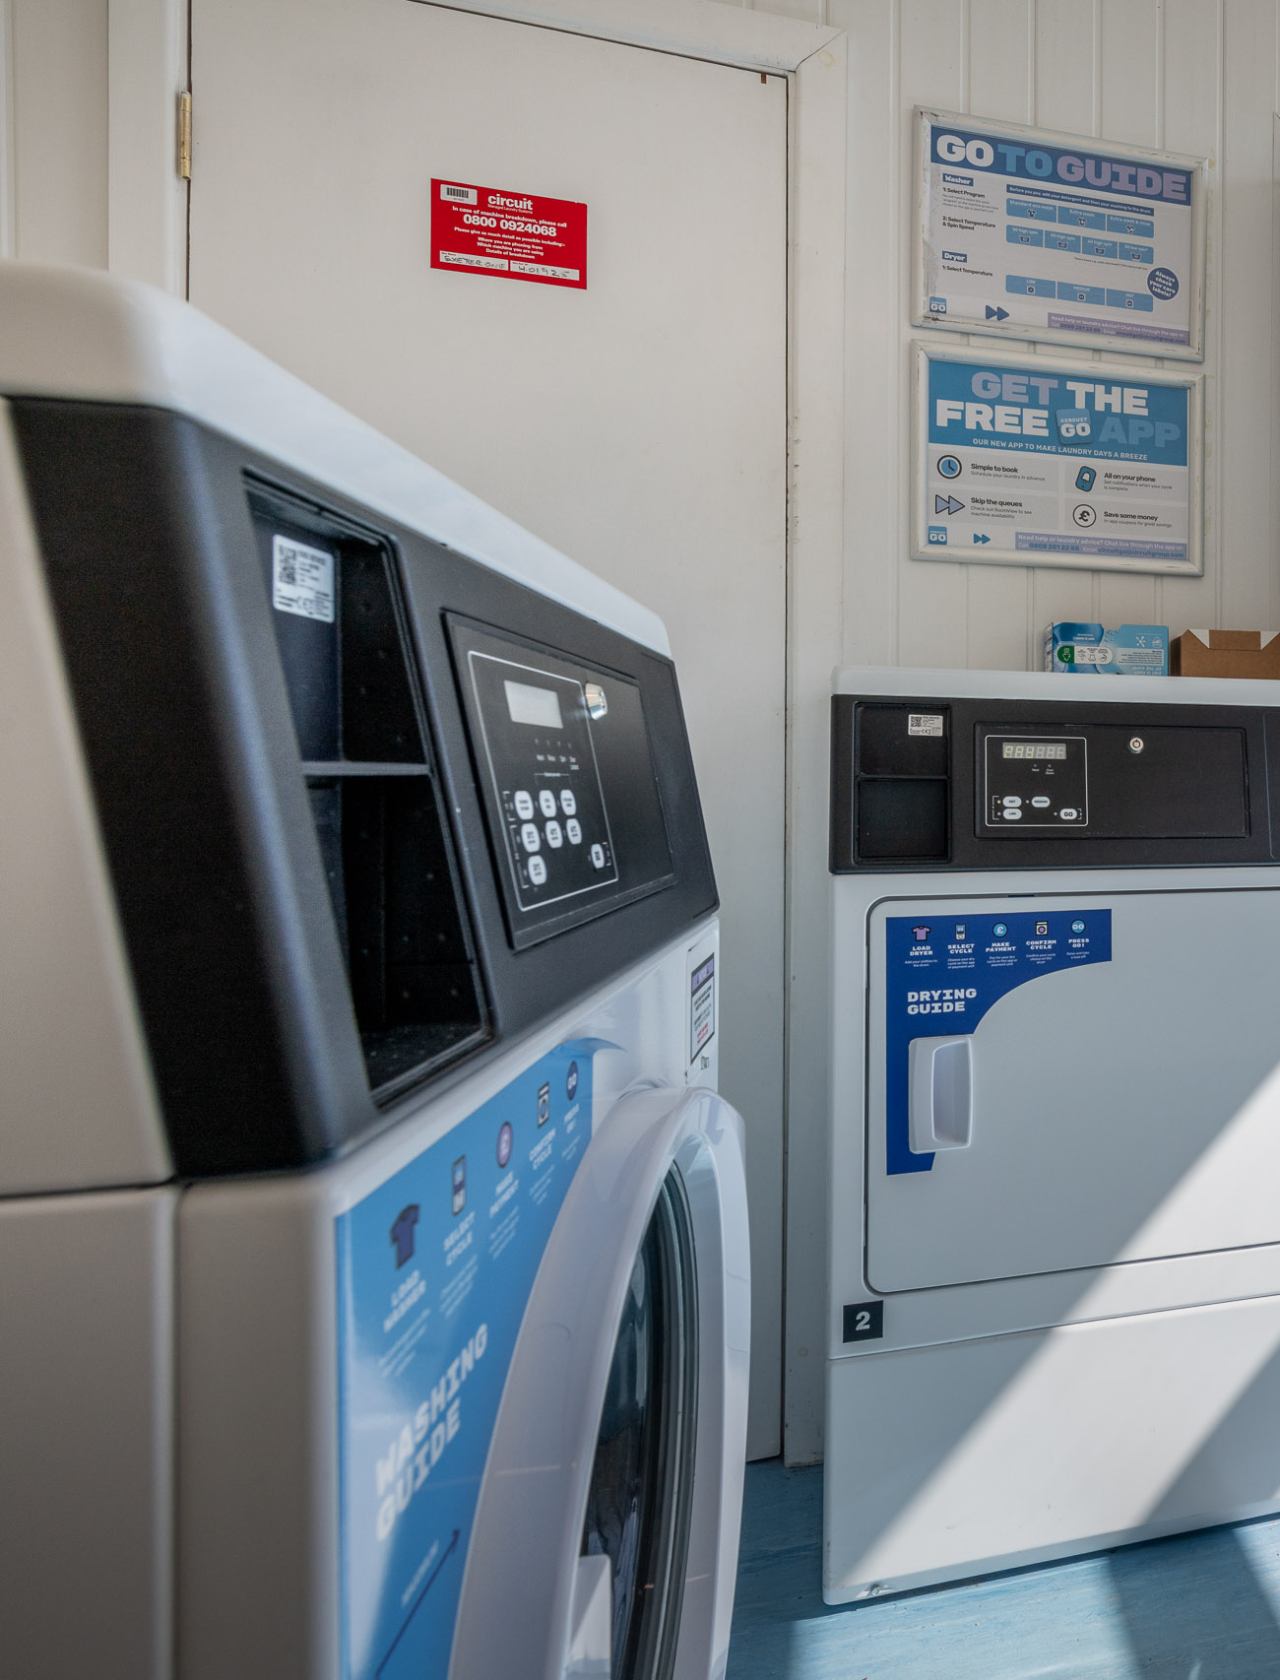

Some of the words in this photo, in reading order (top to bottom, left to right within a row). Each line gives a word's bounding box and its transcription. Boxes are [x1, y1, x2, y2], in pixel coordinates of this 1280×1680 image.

[936, 134, 994, 167] GO
[997, 143, 1053, 177] TO
[1057, 155, 1187, 201] GUIDE
[945, 174, 970, 185] Washer
[488, 194, 534, 210] circuit
[464, 214, 496, 228] 0800
[500, 220, 557, 237] 0924068
[481, 210, 504, 218] machine
[539, 218, 556, 226] please
[964, 219, 996, 228] Temperature
[944, 252, 965, 262] Dryer
[962, 268, 992, 276] Temperature
[1155, 271, 1176, 282] Always
[1156, 277, 1172, 286] check
[930, 303, 945, 312] GO
[971, 372, 1058, 405] GET
[1066, 380, 1149, 416] THE
[936, 399, 1049, 437] FREE
[1060, 423, 1090, 437] GO
[1100, 416, 1181, 448] APP
[991, 440, 1006, 448] NEW
[1058, 446, 1092, 455] LAUNDRY
[1094, 449, 1112, 457] DAYS
[1120, 451, 1148, 460] BREEZE
[971, 464, 993, 472] Simple
[907, 988, 977, 1003] DRYING
[906, 1001, 966, 1015] GUIDE
[856, 1311, 870, 1331] 2
[376, 1323, 488, 1497] WASHING
[377, 1396, 461, 1543] GUIDE
